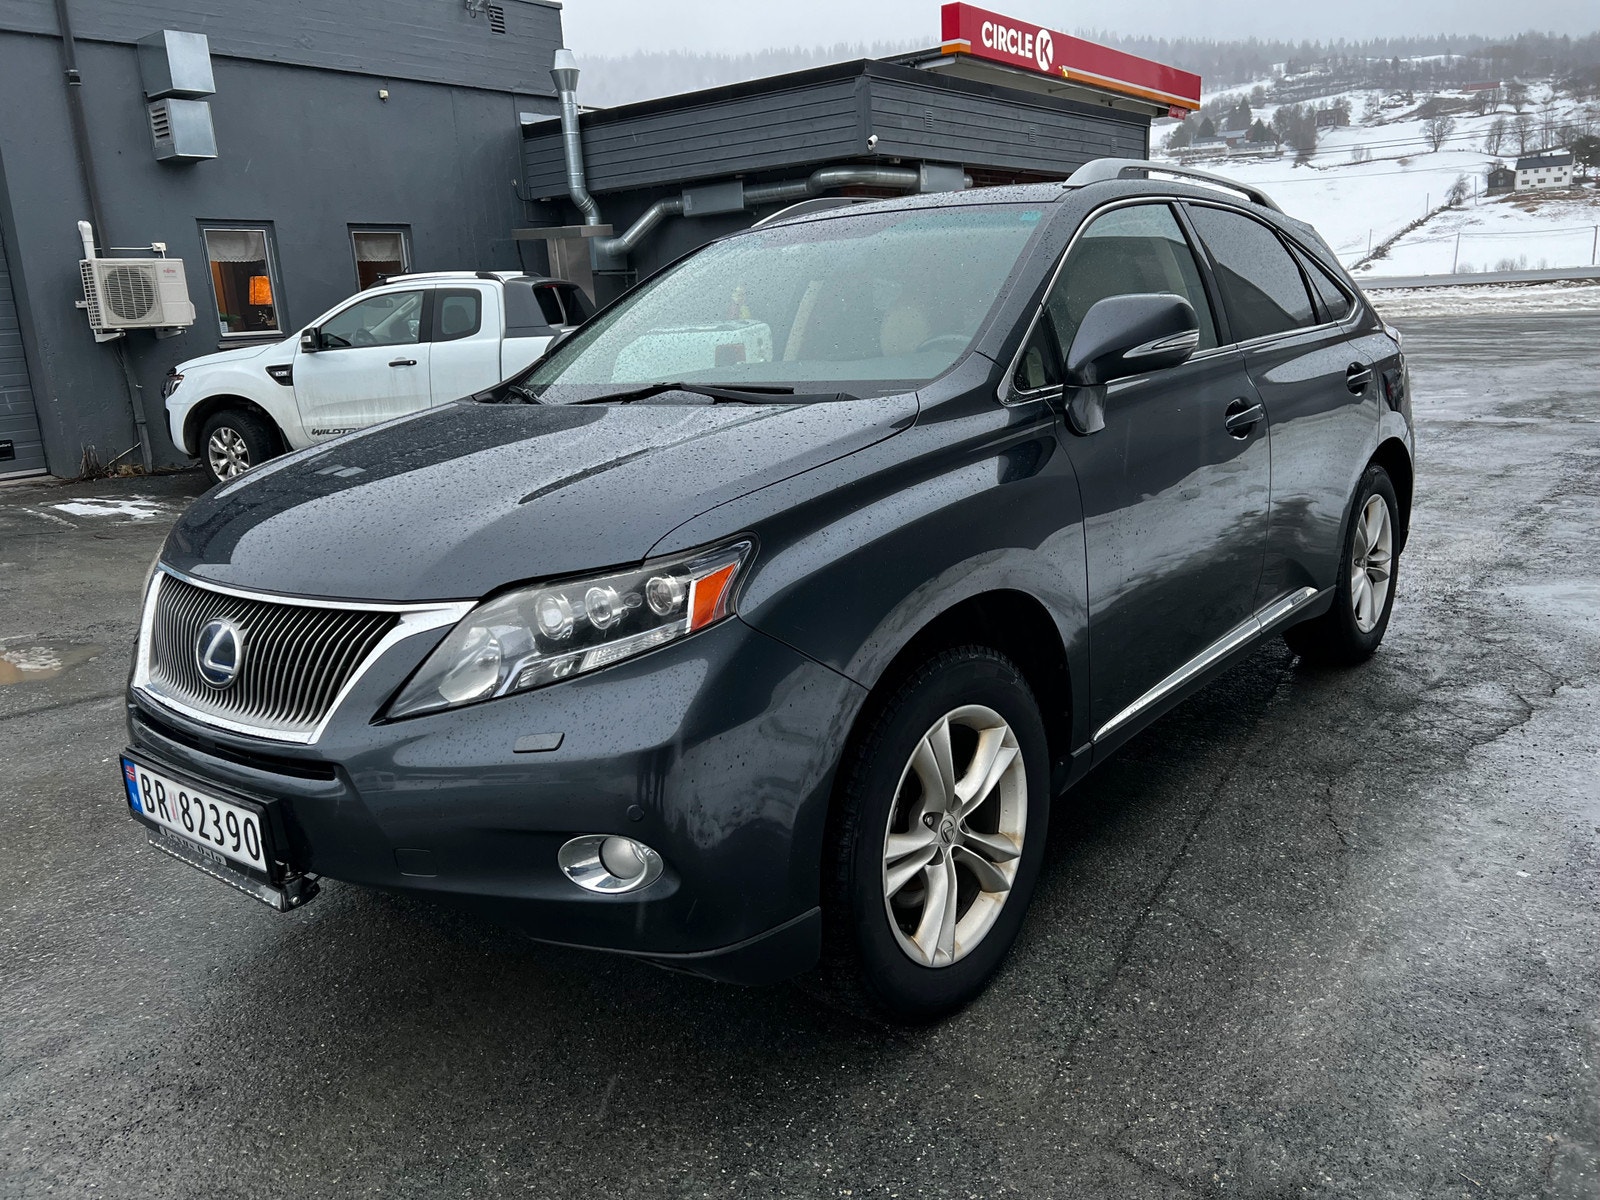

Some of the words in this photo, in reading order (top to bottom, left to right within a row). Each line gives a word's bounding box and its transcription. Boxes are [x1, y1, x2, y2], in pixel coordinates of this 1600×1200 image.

[981, 20, 1033, 58] CIRCLE
[1036, 30, 1053, 70] K
[140, 773, 171, 823] BR
[178, 791, 261, 861] 82390
